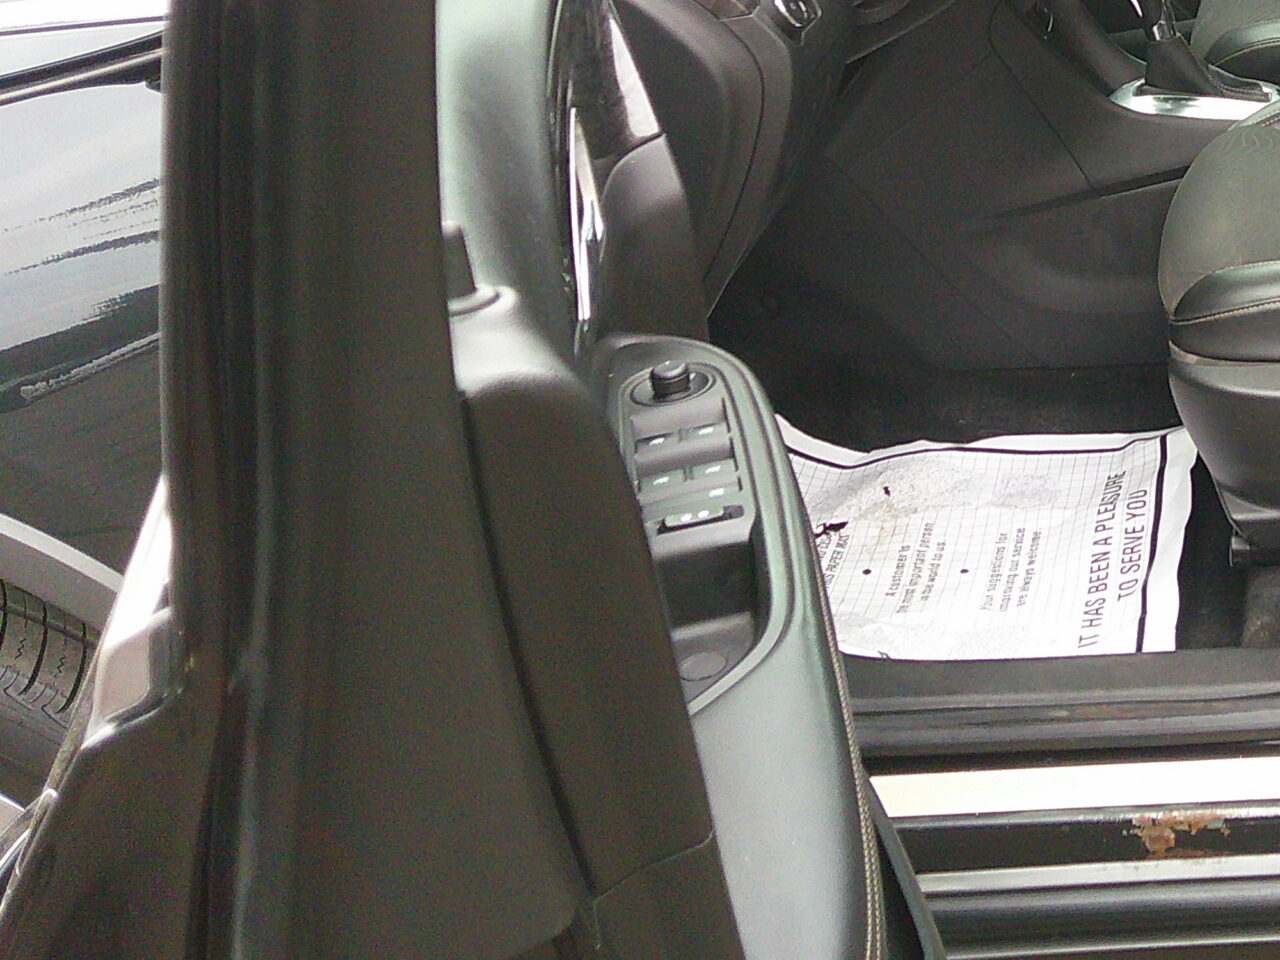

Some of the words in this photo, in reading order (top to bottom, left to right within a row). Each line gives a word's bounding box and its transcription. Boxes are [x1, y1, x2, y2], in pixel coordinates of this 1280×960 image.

[1094, 470, 1127, 533] PLEASURE
[1125, 489, 1148, 521] YOU
[826, 550, 844, 572] PAPER
[836, 534, 850, 549] MAT
[995, 532, 1008, 544] for
[1012, 527, 1026, 558] service
[1093, 536, 1113, 546] A
[1120, 525, 1145, 575] SERVE
[889, 554, 908, 590] customer
[899, 545, 911, 553] is
[909, 549, 927, 587] important
[920, 523, 934, 548] person
[987, 546, 1006, 592] suggestions
[1009, 560, 1020, 572] our
[928, 563, 941, 582] world
[1019, 568, 1036, 592] always
[1088, 551, 1111, 594] BEEN
[1000, 573, 1020, 612] improving
[1017, 594, 1028, 607] are
[1117, 578, 1139, 602] TO
[1081, 597, 1106, 628] HAS
[1077, 634, 1099, 649] IT
